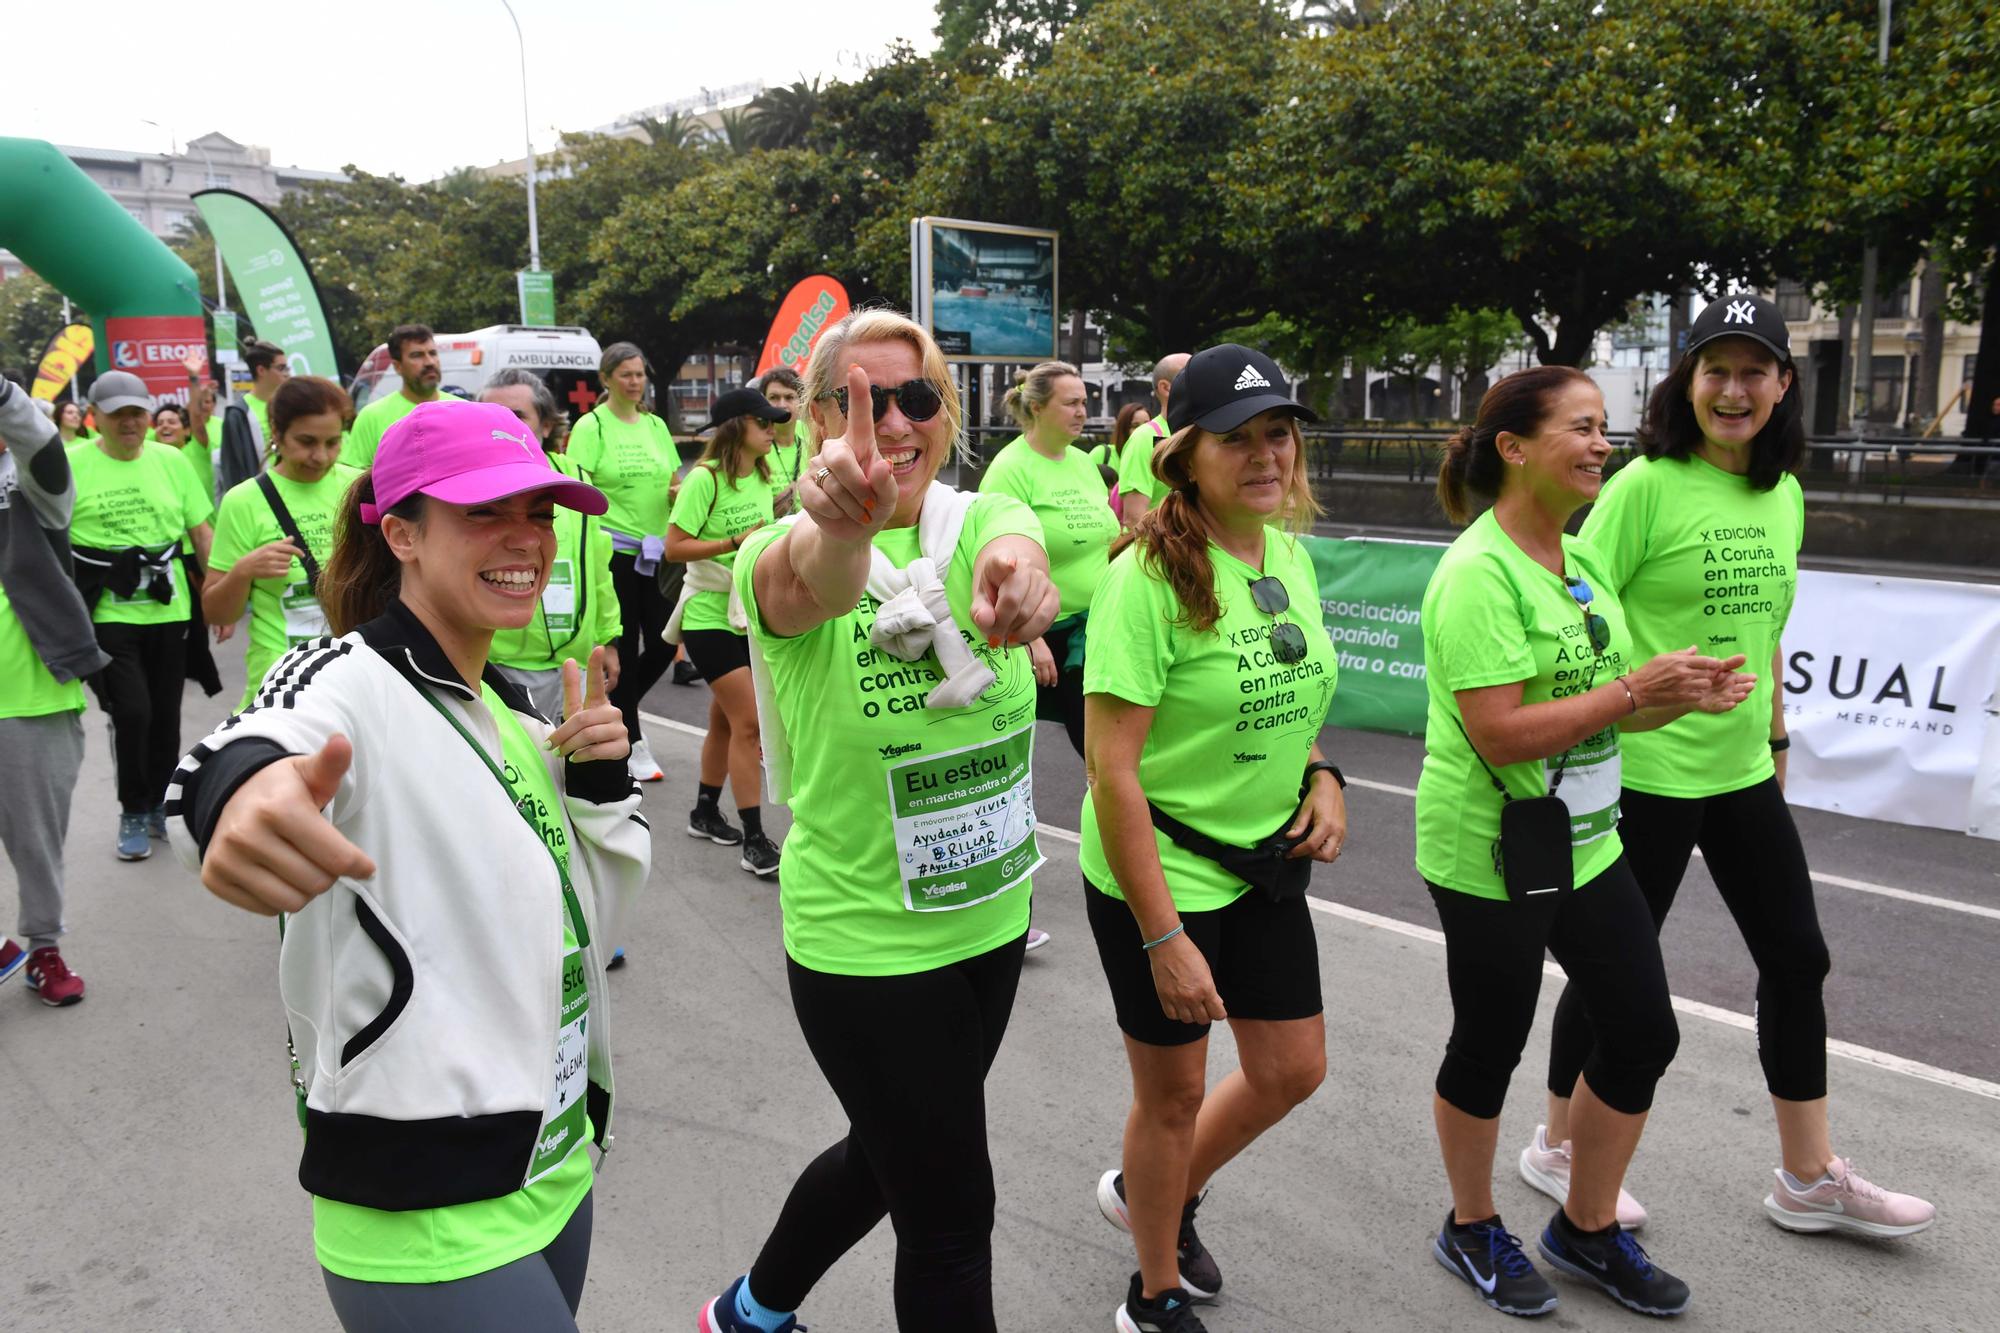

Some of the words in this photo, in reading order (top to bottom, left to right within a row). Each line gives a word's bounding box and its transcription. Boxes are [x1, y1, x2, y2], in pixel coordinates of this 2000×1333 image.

[507, 354, 595, 366] AMBULANCIA
[1234, 379, 1271, 391] adidas
[108, 498, 146, 508] Coruña
[115, 506, 155, 516] marcha
[725, 519, 733, 527] A
[1700, 530, 1712, 543] X
[1714, 524, 1766, 541] EDICIÓN
[1703, 549, 1717, 564] A
[1721, 545, 1775, 561] Coruña
[1704, 569, 1728, 581] en
[1733, 562, 1787, 579] marcha
[1704, 582, 1759, 599] contra
[1704, 604, 1716, 616] o
[1721, 600, 1773, 615] cancro
[853, 621, 867, 643] A
[1227, 633, 1240, 648] X
[1324, 625, 1399, 649] spañola
[1237, 654, 1252, 673] A
[1555, 647, 1571, 664] A
[1240, 677, 1266, 694] en
[1270, 660, 1324, 688] marcha
[1371, 658, 1385, 673] o
[1388, 661, 1428, 680] can
[1554, 668, 1579, 681] en
[859, 667, 939, 693] contra
[1782, 650, 1957, 714] SUAL
[863, 701, 880, 718] o
[1239, 690, 1295, 714] contra
[1235, 720, 1248, 732] o
[1253, 706, 1308, 730] cancro
[1837, 711, 1954, 736] MERCHAND
[878, 742, 922, 756] Vegalsa
[1233, 752, 1267, 762] Vegalsa
[906, 771, 939, 793] Eu
[944, 753, 1008, 785] estou
[909, 799, 923, 808] en
[926, 788, 967, 805] marcha
[968, 779, 1000, 795] contra
[1001, 776, 1007, 784] o
[920, 814, 955, 827] móvome
[913, 822, 974, 850] Ayudando
[922, 881, 968, 897] Vegalsa
[563, 964, 585, 993] sto
[555, 1044, 587, 1091] MALENA!
